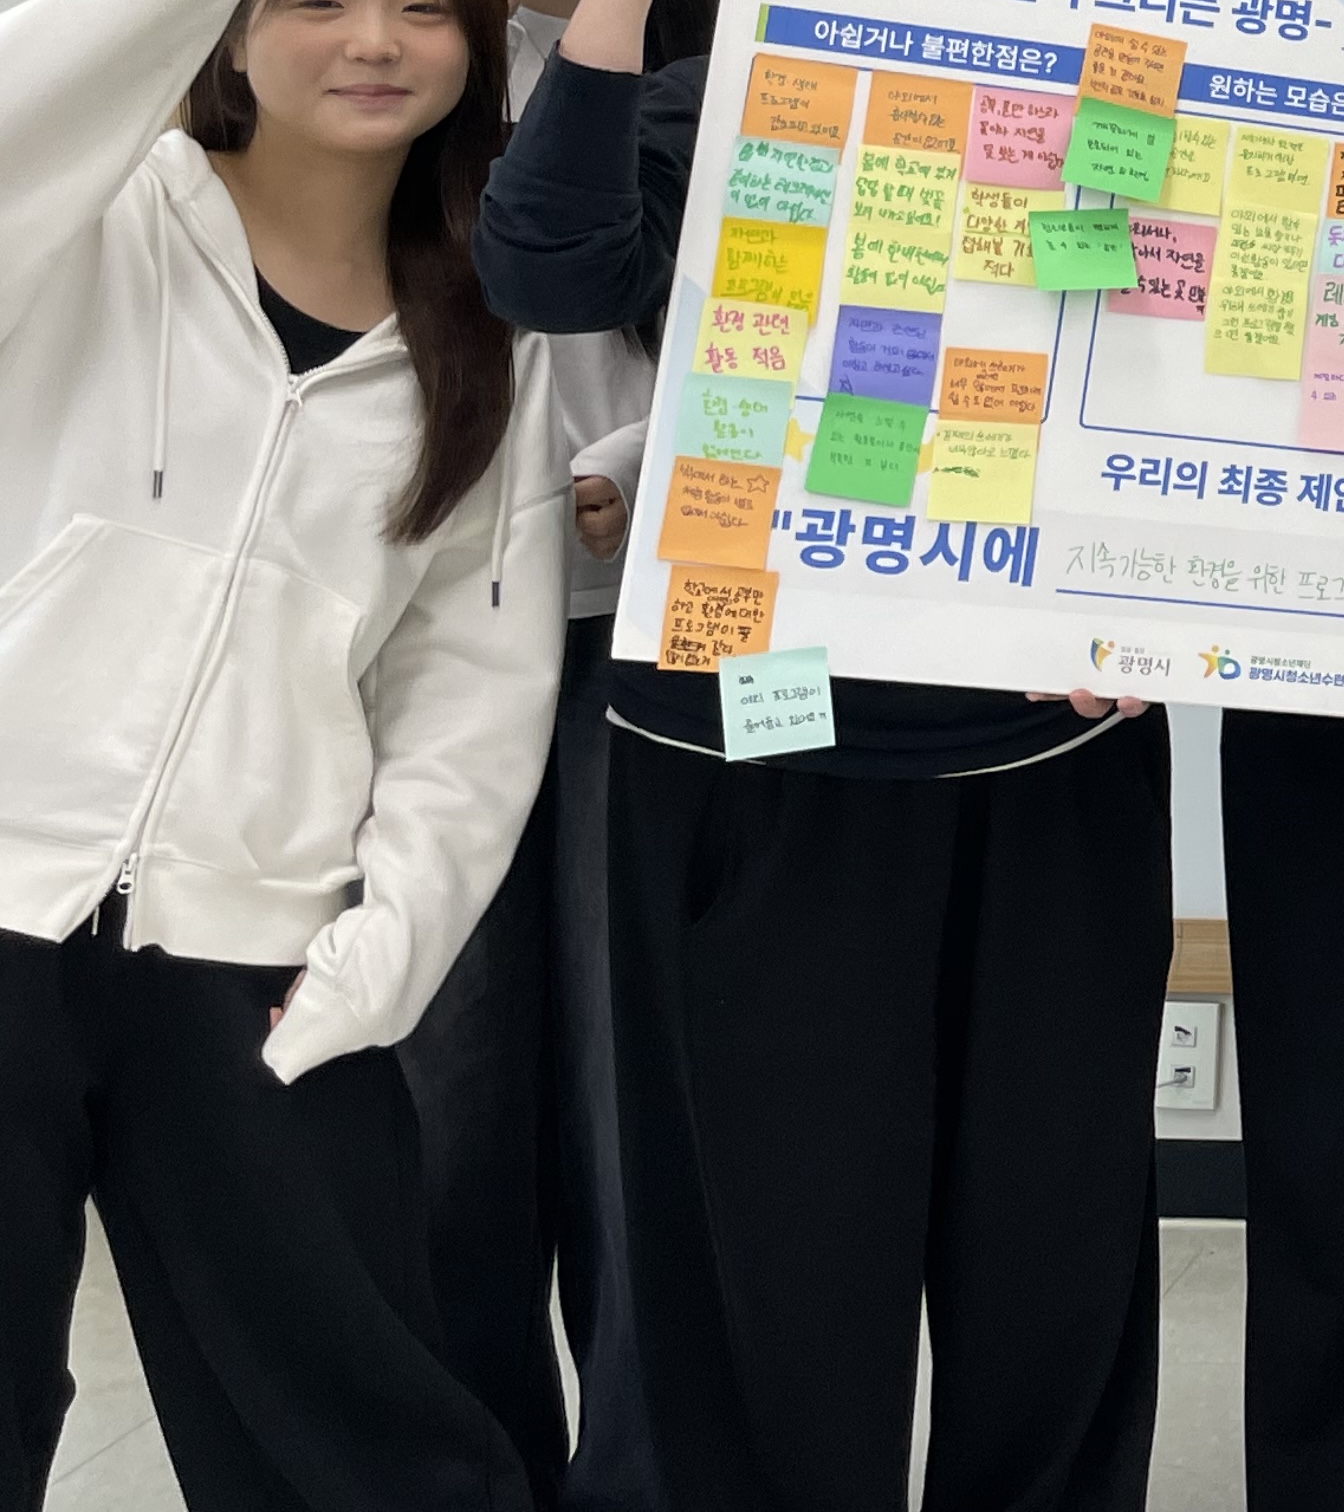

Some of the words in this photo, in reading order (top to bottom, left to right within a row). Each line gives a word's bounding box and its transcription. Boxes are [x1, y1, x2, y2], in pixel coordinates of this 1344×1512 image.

[813, 18, 914, 58] 아쉽거나
[920, 32, 1058, 76] 불편한점은?
[1208, 74, 1279, 108] 원하는
[752, 311, 790, 336] 관련
[1101, 453, 1208, 500] 우리의
[1217, 464, 1289, 507] 최종
[1186, 552, 1243, 594] 환경을
